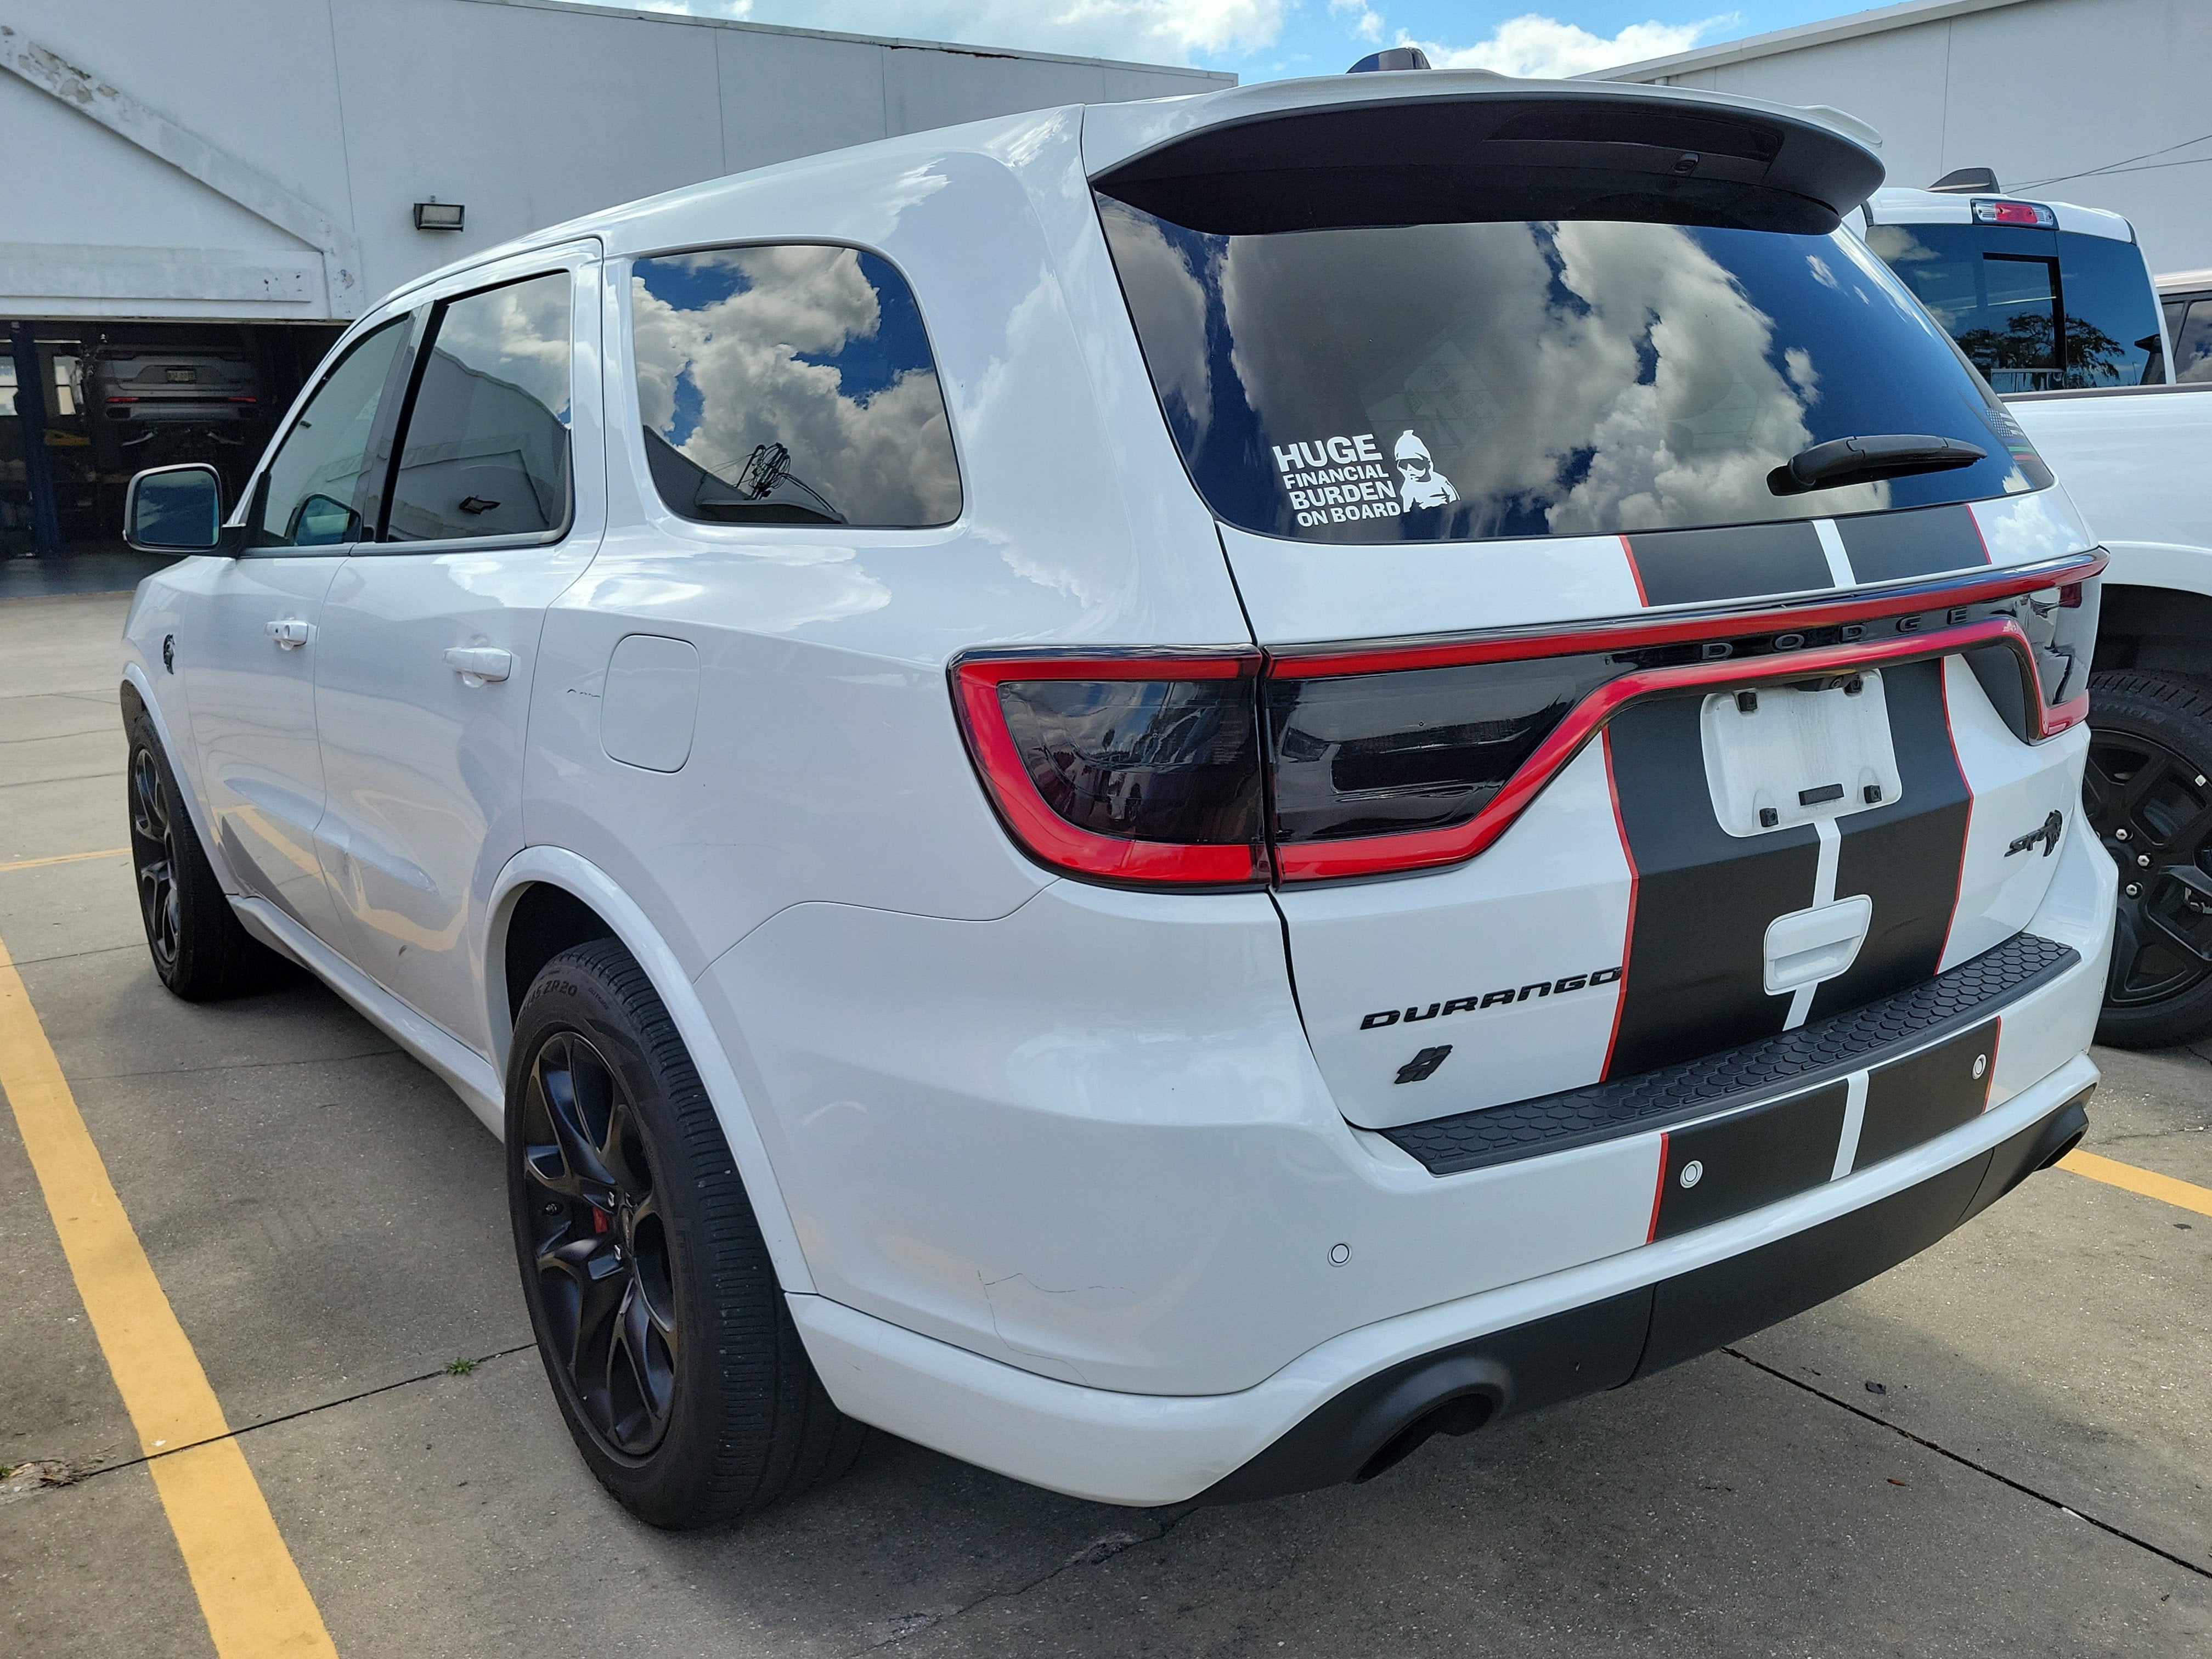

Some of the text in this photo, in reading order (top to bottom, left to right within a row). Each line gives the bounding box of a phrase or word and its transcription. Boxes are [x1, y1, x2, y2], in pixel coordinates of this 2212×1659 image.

[1272, 434, 1383, 473] HUGE
[1282, 463, 1390, 489] FINANCIAL
[1288, 480, 1397, 510] BURDEN
[1297, 501, 1401, 527] ON BOARD
[1702, 606, 1969, 659] DODGE
[543, 979, 579, 997] ZR20
[1359, 966, 1623, 1030] DURANGO
